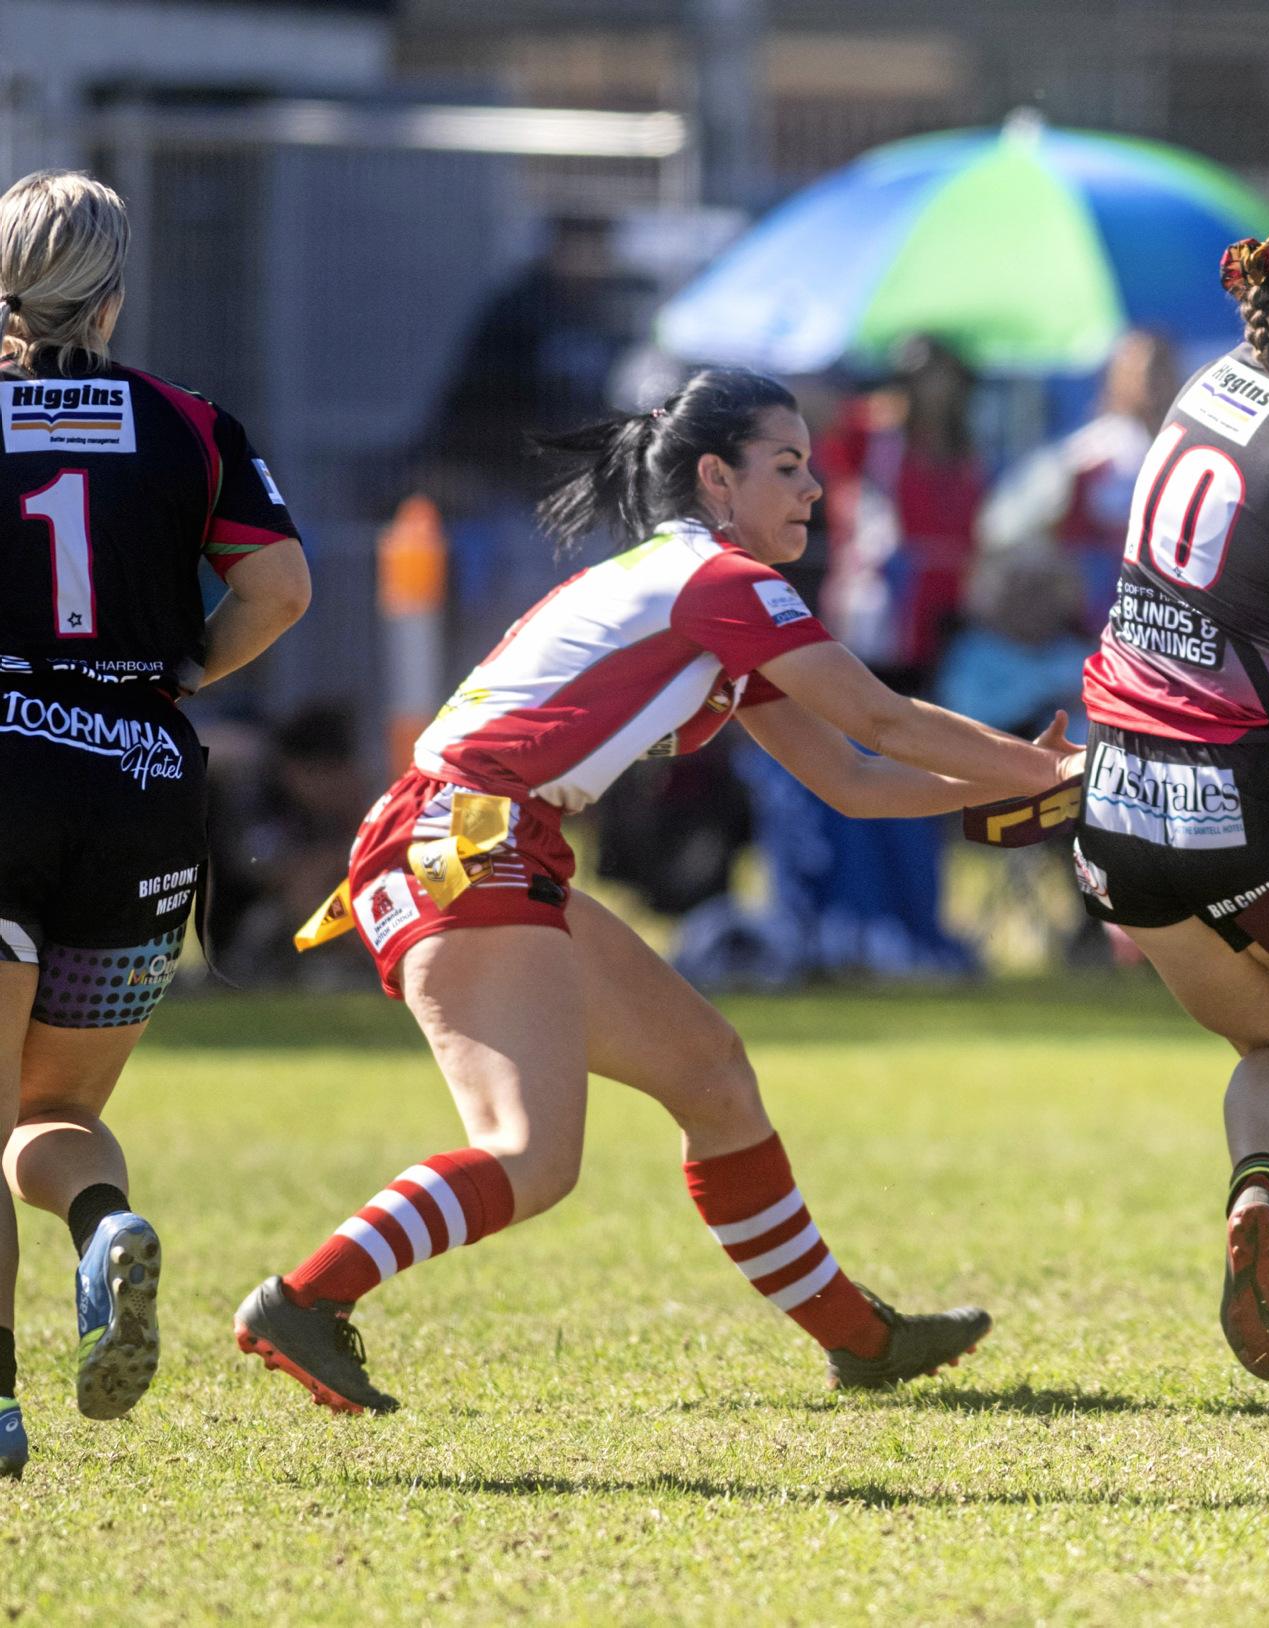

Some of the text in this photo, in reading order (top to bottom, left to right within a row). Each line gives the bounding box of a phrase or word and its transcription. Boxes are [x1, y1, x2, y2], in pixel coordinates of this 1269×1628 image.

[12, 385, 124, 409] Higgins
[1123, 422, 1245, 592] 10
[20, 468, 97, 639] 1
[1123, 595, 1193, 633] BLINDS
[1200, 618, 1218, 640] &
[95, 660, 164, 671] HARBOUR
[3, 691, 180, 756] TOORMINA
[120, 741, 183, 790] Hotel
[139, 876, 161, 898] BIG
[156, 890, 191, 916] MEATS
[1207, 899, 1238, 919] BIG
